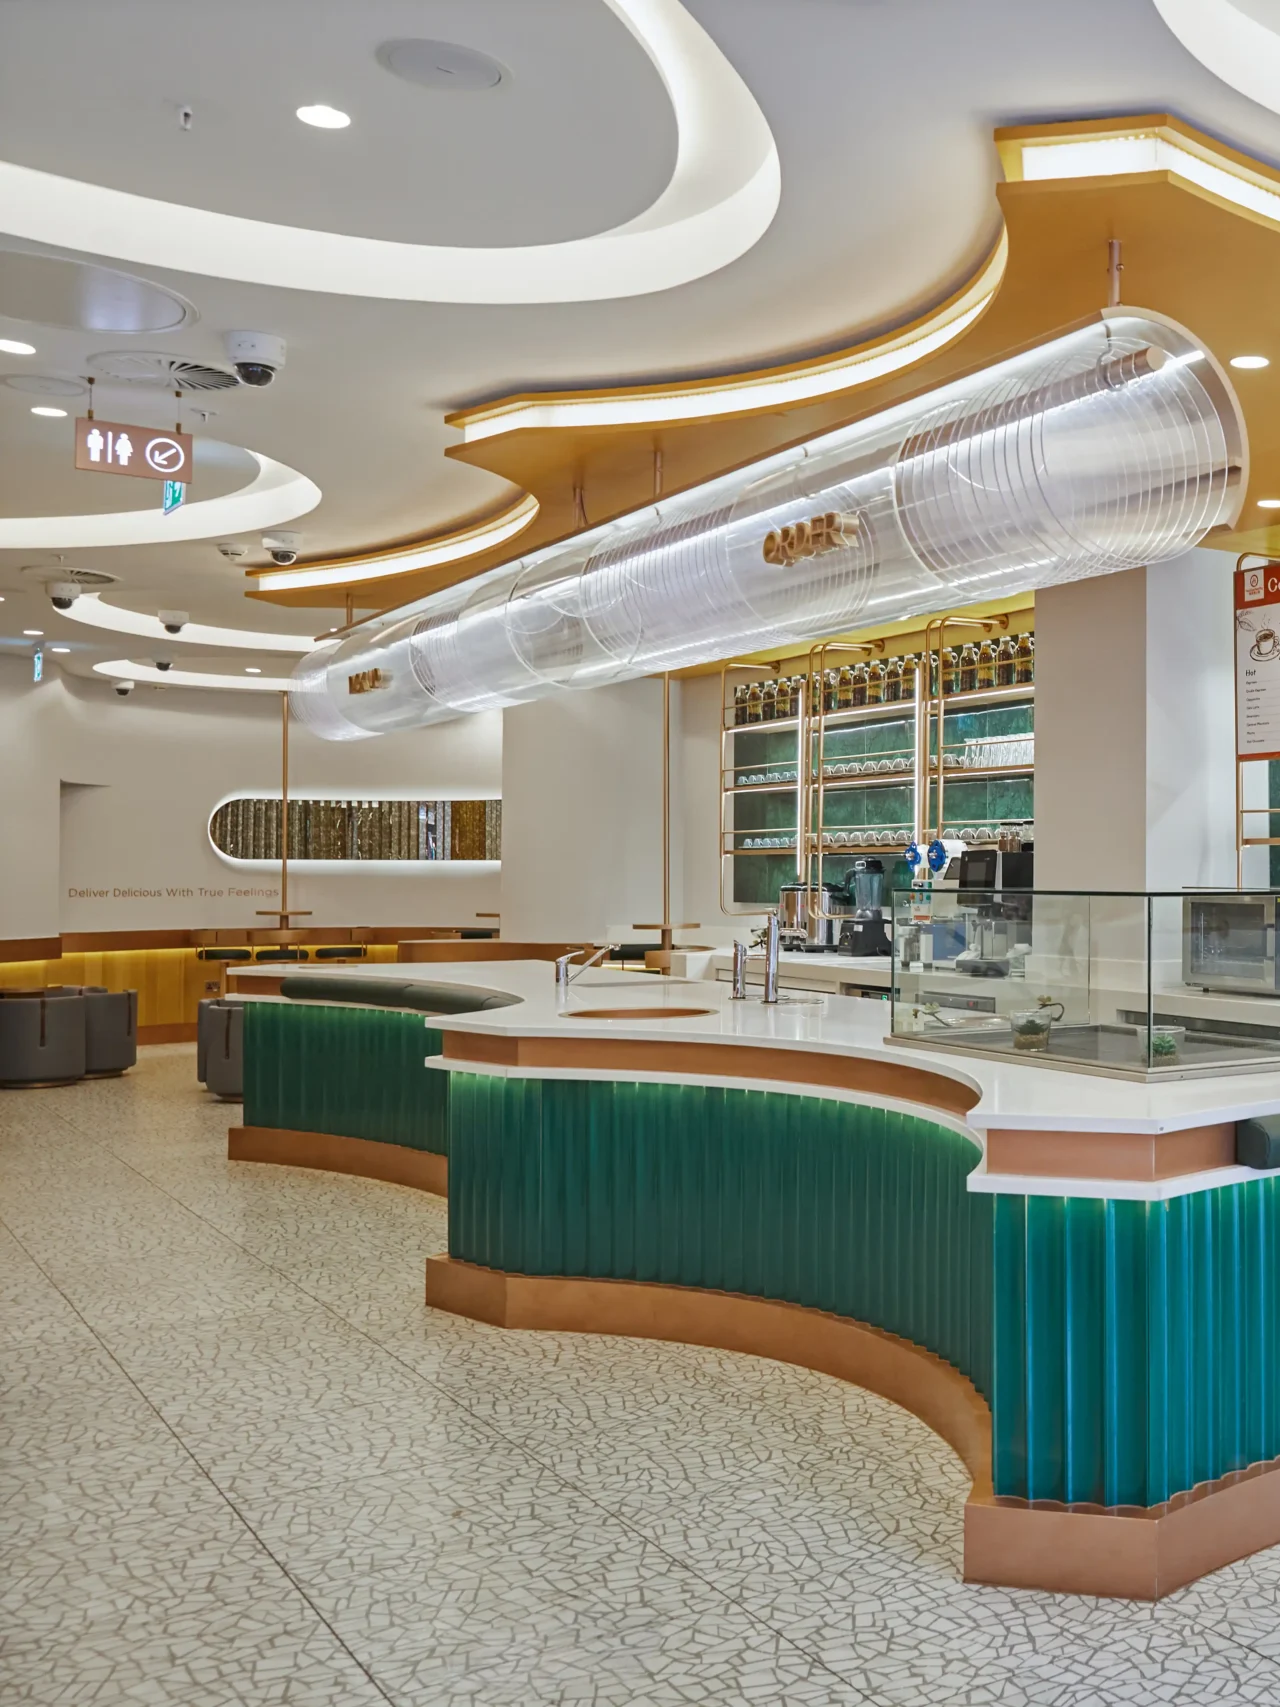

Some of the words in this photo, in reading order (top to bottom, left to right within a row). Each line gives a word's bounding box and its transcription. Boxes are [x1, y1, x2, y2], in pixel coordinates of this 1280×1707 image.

[68, 887, 109, 898] Deliver
[113, 887, 162, 898] Delicious
[166, 887, 194, 898] With
[198, 887, 224, 897] True
[228, 887, 280, 898] Feelings
